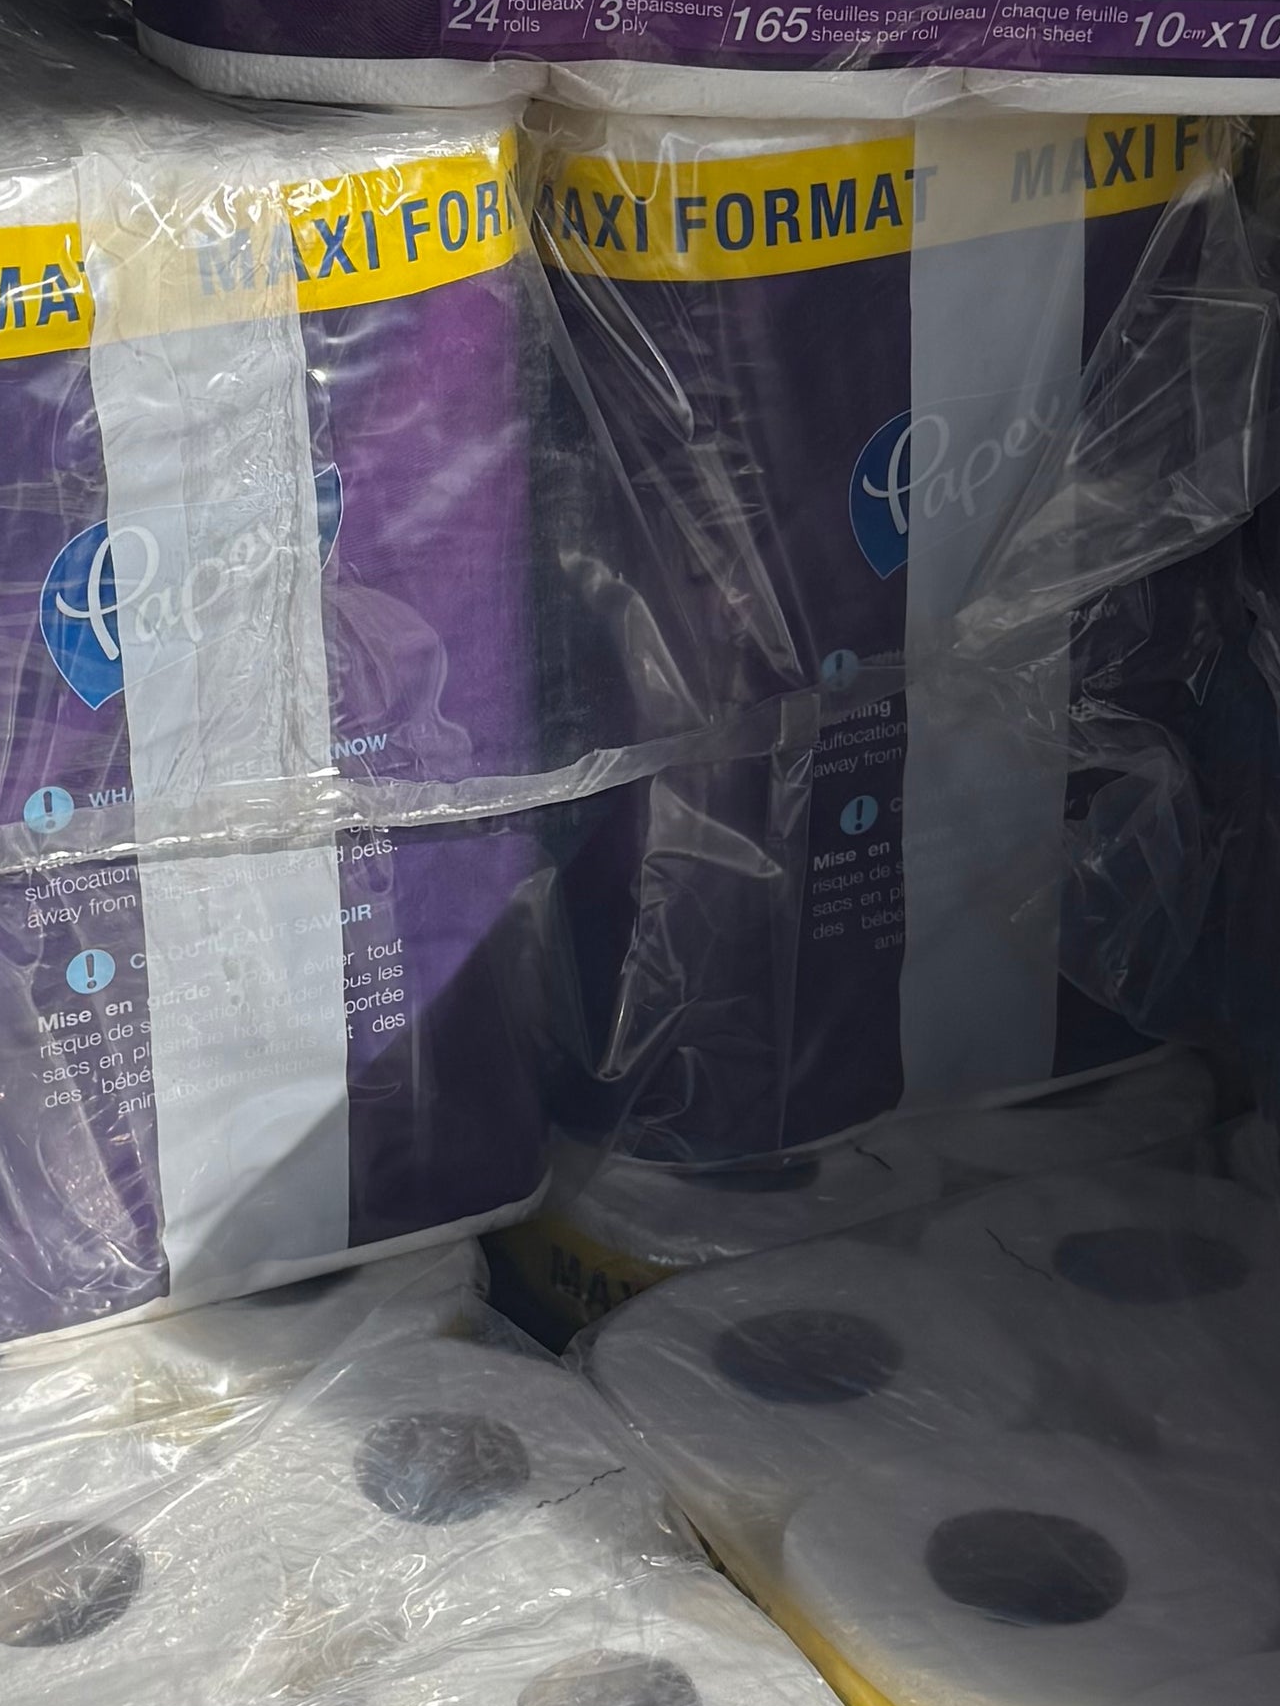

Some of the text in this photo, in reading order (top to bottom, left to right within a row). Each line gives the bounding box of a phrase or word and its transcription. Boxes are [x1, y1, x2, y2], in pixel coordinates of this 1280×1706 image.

[503, 16, 541, 33] rolls
[622, 17, 649, 36] ply
[810, 25, 873, 43] sheets
[876, 29, 907, 46] per
[911, 25, 939, 40] roll
[992, 24, 1038, 41] each
[1041, 26, 1093, 44] sheet
[731, 5, 812, 43] 165
[816, 4, 880, 24] feuilles
[884, 11, 915, 27] par
[920, 5, 987, 23] rouleau
[1001, 2, 1070, 24] chaque
[1074, 4, 1130, 25] feuille
[675, 165, 939, 255] FORMAT
[1010, 122, 1157, 204] MAXI
[197, 215, 381, 295] MAXI
[401, 165, 519, 263] FOR
[333, 733, 388, 759] NOW
[812, 719, 908, 755] suffocation
[812, 744, 903, 780] away from
[812, 841, 891, 873] Mise en
[23, 864, 140, 904] suffocation
[27, 904, 82, 931] away
[88, 892, 137, 917] from
[351, 839, 400, 869] pets.
[812, 871, 865, 895] risque
[868, 863, 891, 881] de
[812, 897, 854, 918] sacs
[860, 890, 882, 907] en
[812, 920, 845, 941] des
[36, 1008, 93, 1033] Mise
[104, 999, 133, 1016] en
[147, 985, 210, 1013] garde
[367, 938, 403, 960] tout
[39, 1031, 103, 1061] risque
[108, 1022, 134, 1042] de
[376, 962, 405, 981] les
[42, 986, 405, 1084] sacs en portée
[43, 1088, 83, 1110] des
[371, 1010, 407, 1033] des
